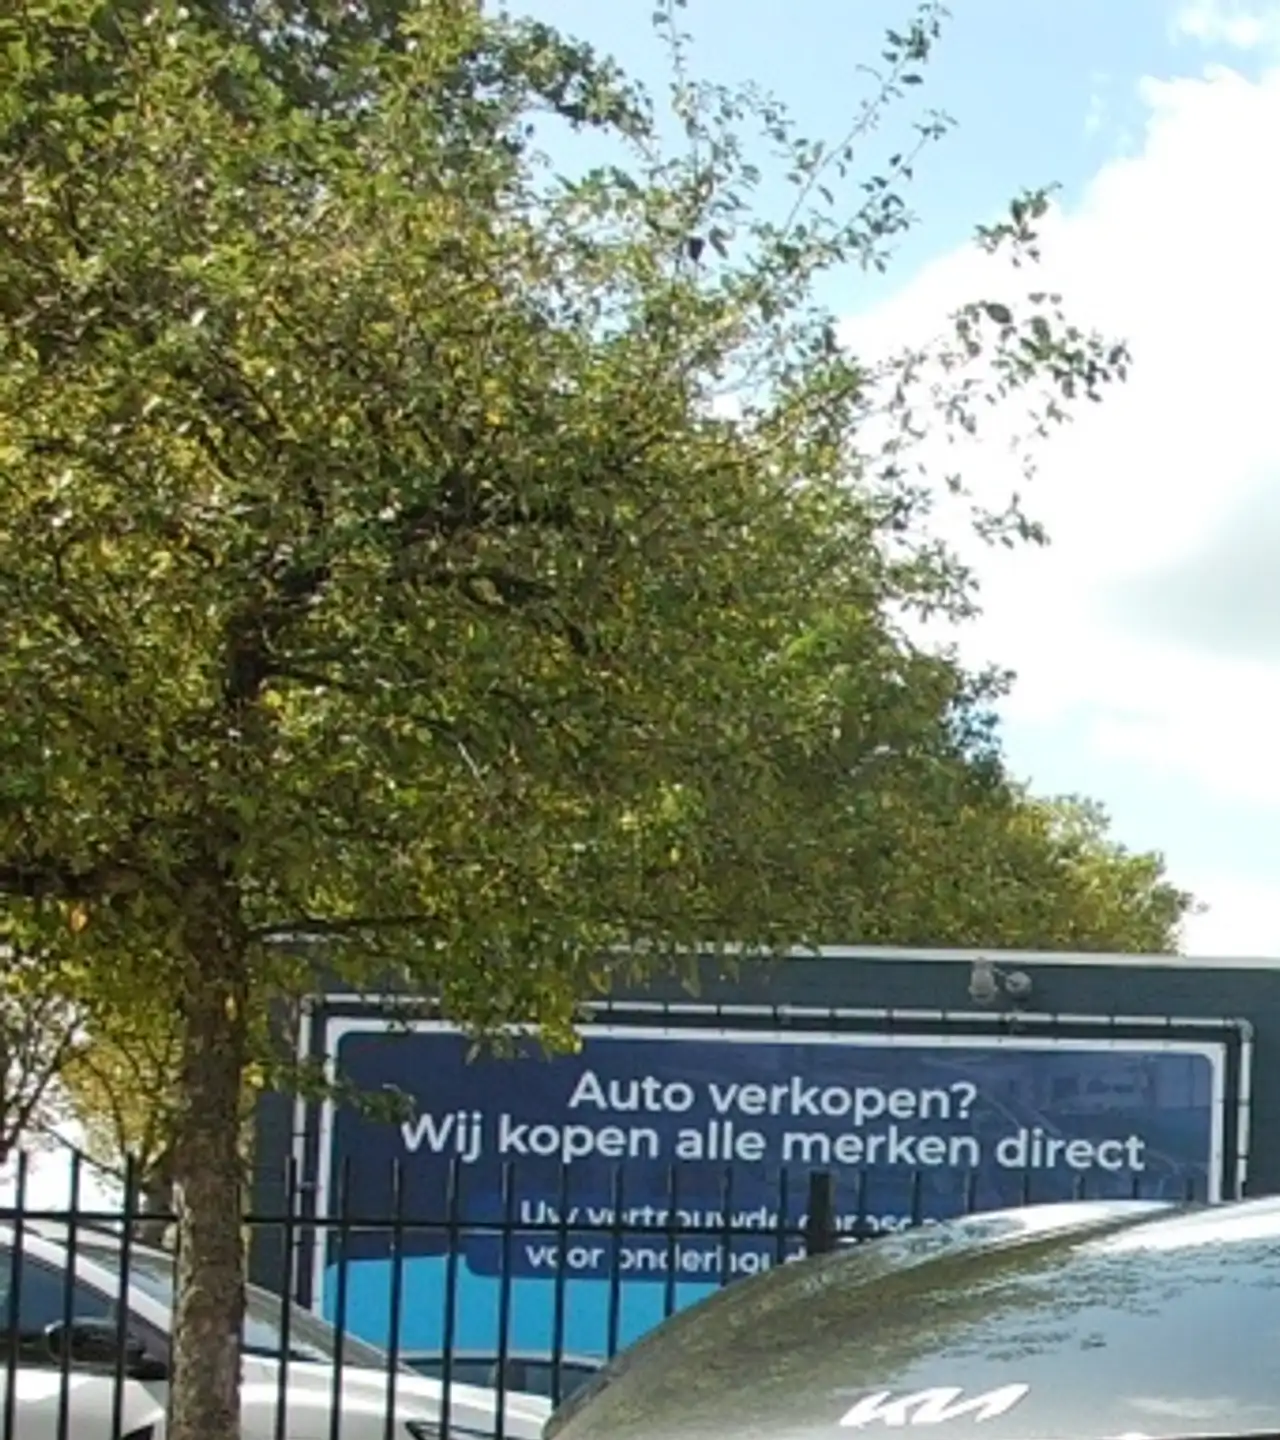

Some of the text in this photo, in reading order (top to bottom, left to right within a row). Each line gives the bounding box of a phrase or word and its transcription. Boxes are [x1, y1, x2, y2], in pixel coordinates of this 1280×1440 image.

[567, 1069, 977, 1126] Auto verkopen?
[401, 1111, 1145, 1171] Wij kopen alle merken direct
